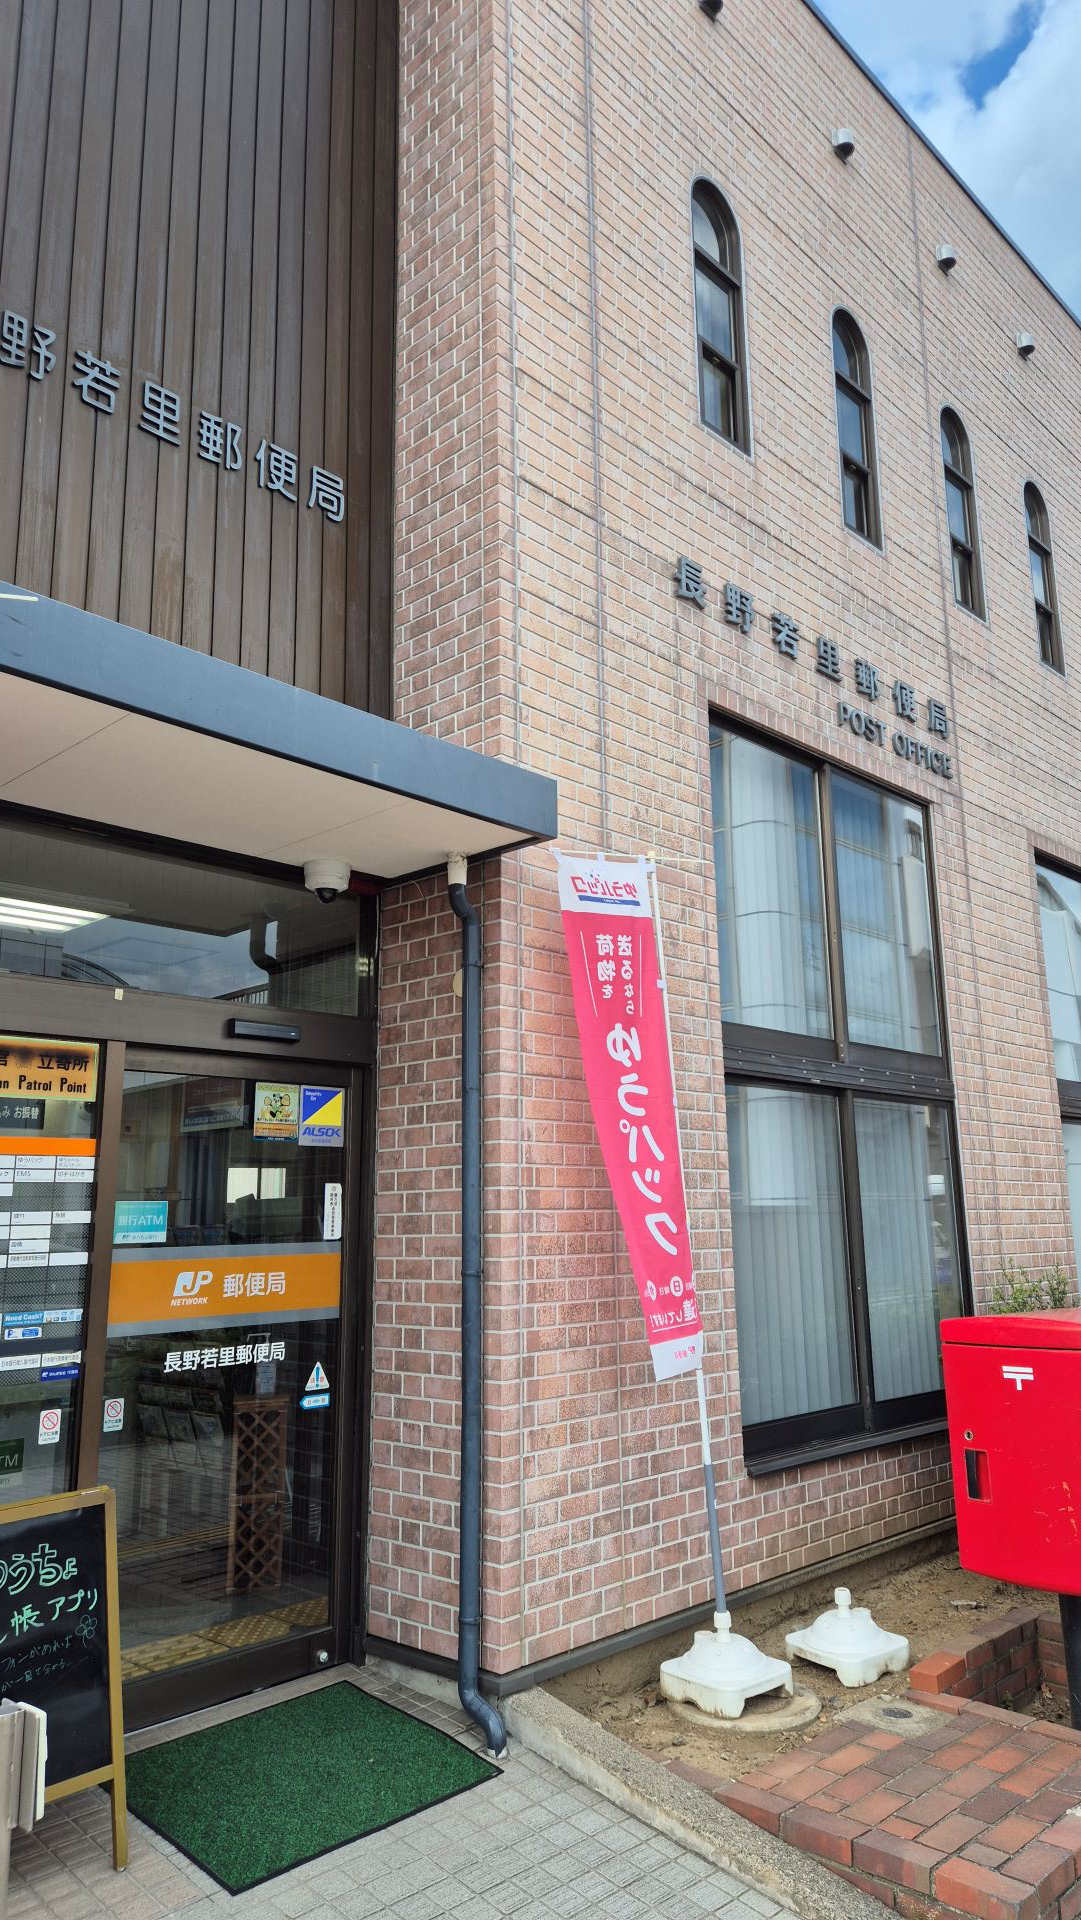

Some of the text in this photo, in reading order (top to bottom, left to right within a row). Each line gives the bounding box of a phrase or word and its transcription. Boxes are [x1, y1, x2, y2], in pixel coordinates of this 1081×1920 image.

[674, 556, 949, 740] 長野若里郵便局
[837, 701, 953, 780] POST OFFICE
[18, 1074, 52, 1092] Patrol
[59, 1077, 87, 1094] Point
[13, 1105, 40, 1120] お振替
[302, 1126, 341, 1138] ALSOK
[173, 1270, 214, 1297] JP
[222, 1271, 286, 1298] 郵便局
[170, 1296, 209, 1307] NETWORK
[163, 1341, 286, 1374] 長野若里郵便局
